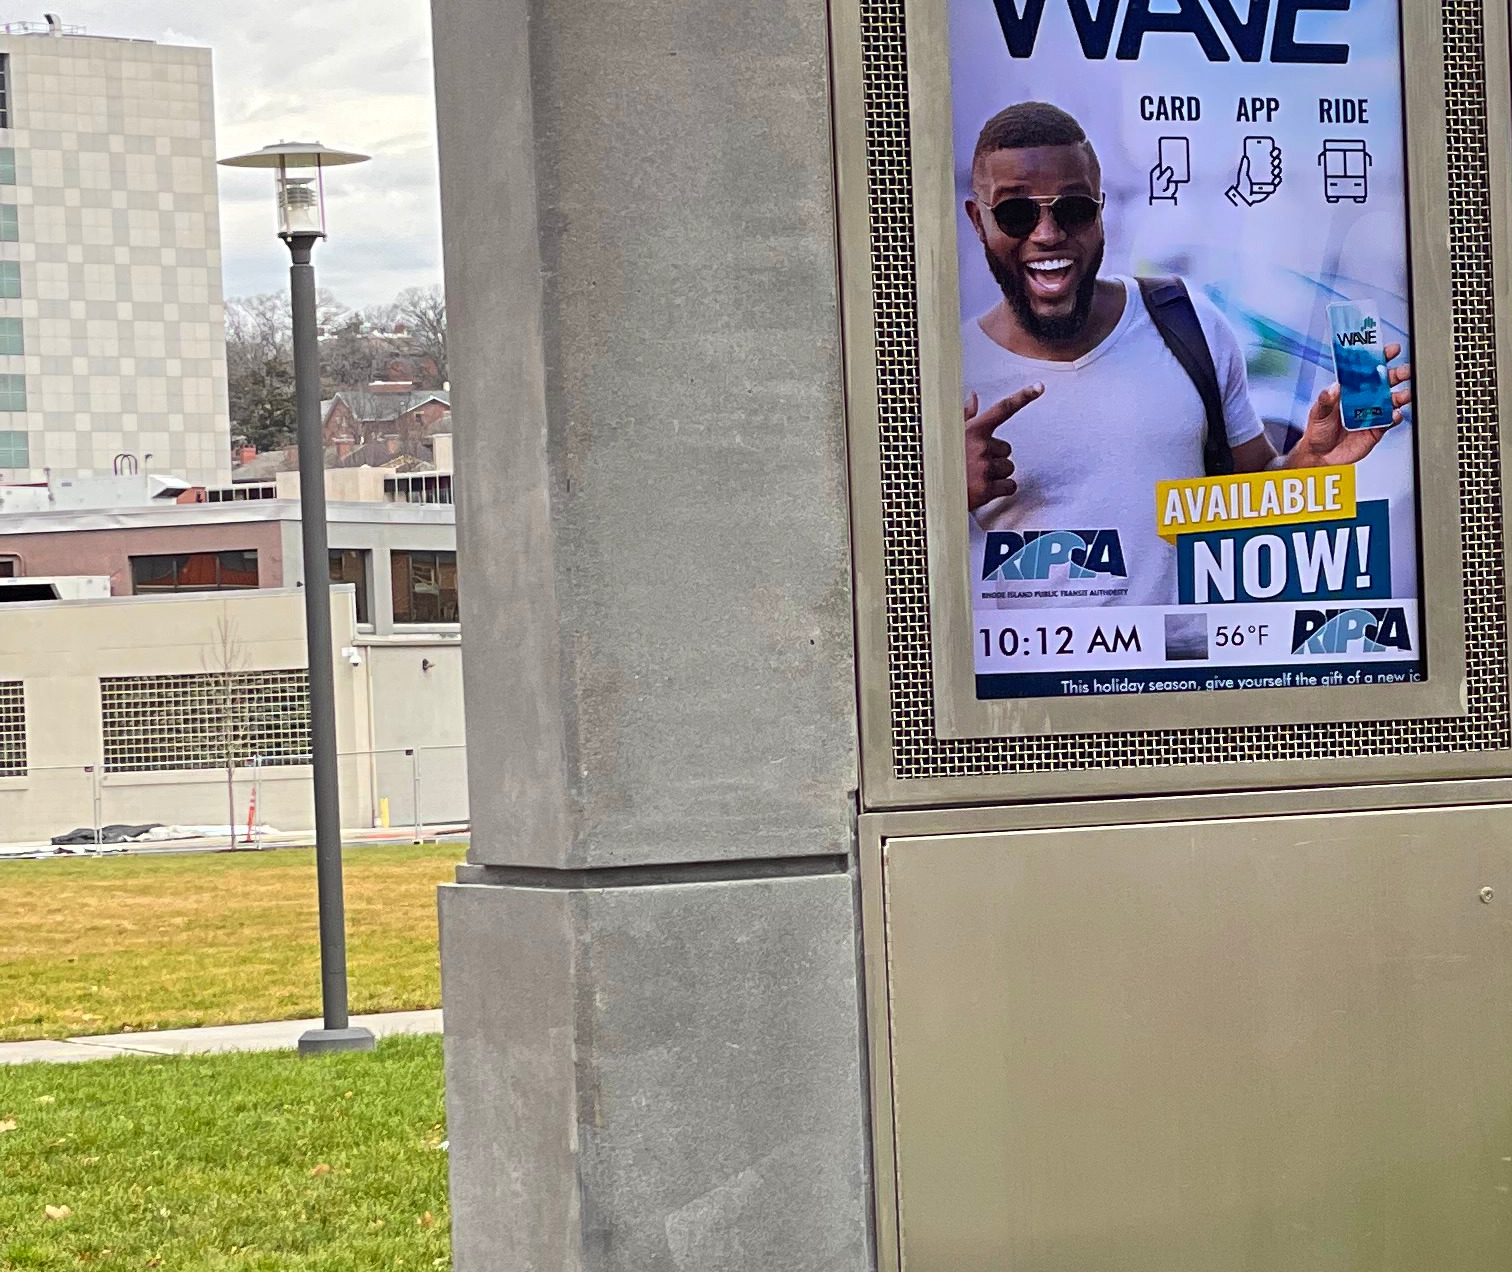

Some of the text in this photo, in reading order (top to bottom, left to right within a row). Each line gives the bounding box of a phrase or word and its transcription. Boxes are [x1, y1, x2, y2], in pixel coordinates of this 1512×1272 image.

[1140, 96, 1369, 123] CARD APP RIDE
[1337, 330, 1377, 346] WAVE
[1164, 475, 1341, 525] AVAILABLE
[982, 529, 1128, 580] RIPTA
[1194, 525, 1371, 603] NOW!
[979, 625, 1142, 657] 10:12 AM
[1215, 625, 1269, 648] 56°F
[1291, 607, 1412, 654] RIPTA
[1061, 680, 1089, 694] This
[1094, 678, 1145, 694] holiday
[1149, 679, 1201, 692] season,
[1206, 676, 1234, 691] give
[1238, 673, 1292, 689] yourself
[1295, 672, 1317, 685] the
[1321, 671, 1343, 687] gift
[1347, 670, 1361, 684] of
[1364, 674, 1373, 683] a
[1377, 672, 1405, 683] new
